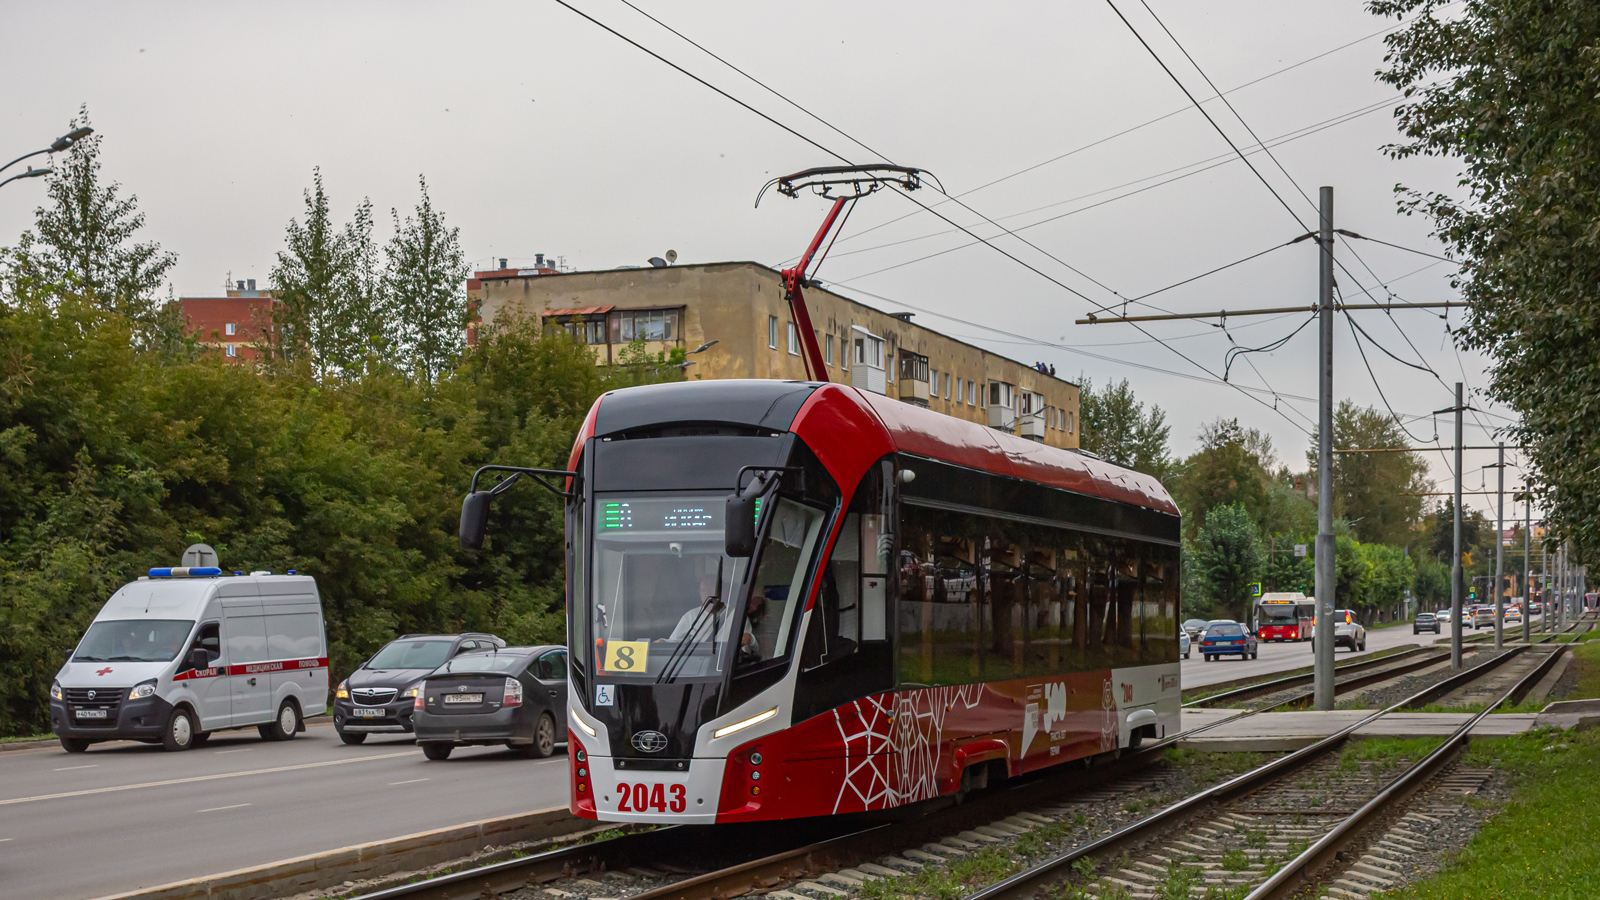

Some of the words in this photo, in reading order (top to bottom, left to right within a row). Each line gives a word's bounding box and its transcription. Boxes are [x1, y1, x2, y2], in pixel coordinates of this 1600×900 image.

[195, 668, 217, 677] СКОРАЯ
[298, 660, 320, 668] ПОМОЩЬ
[613, 646, 635, 670] 8
[616, 783, 687, 813] 2043
